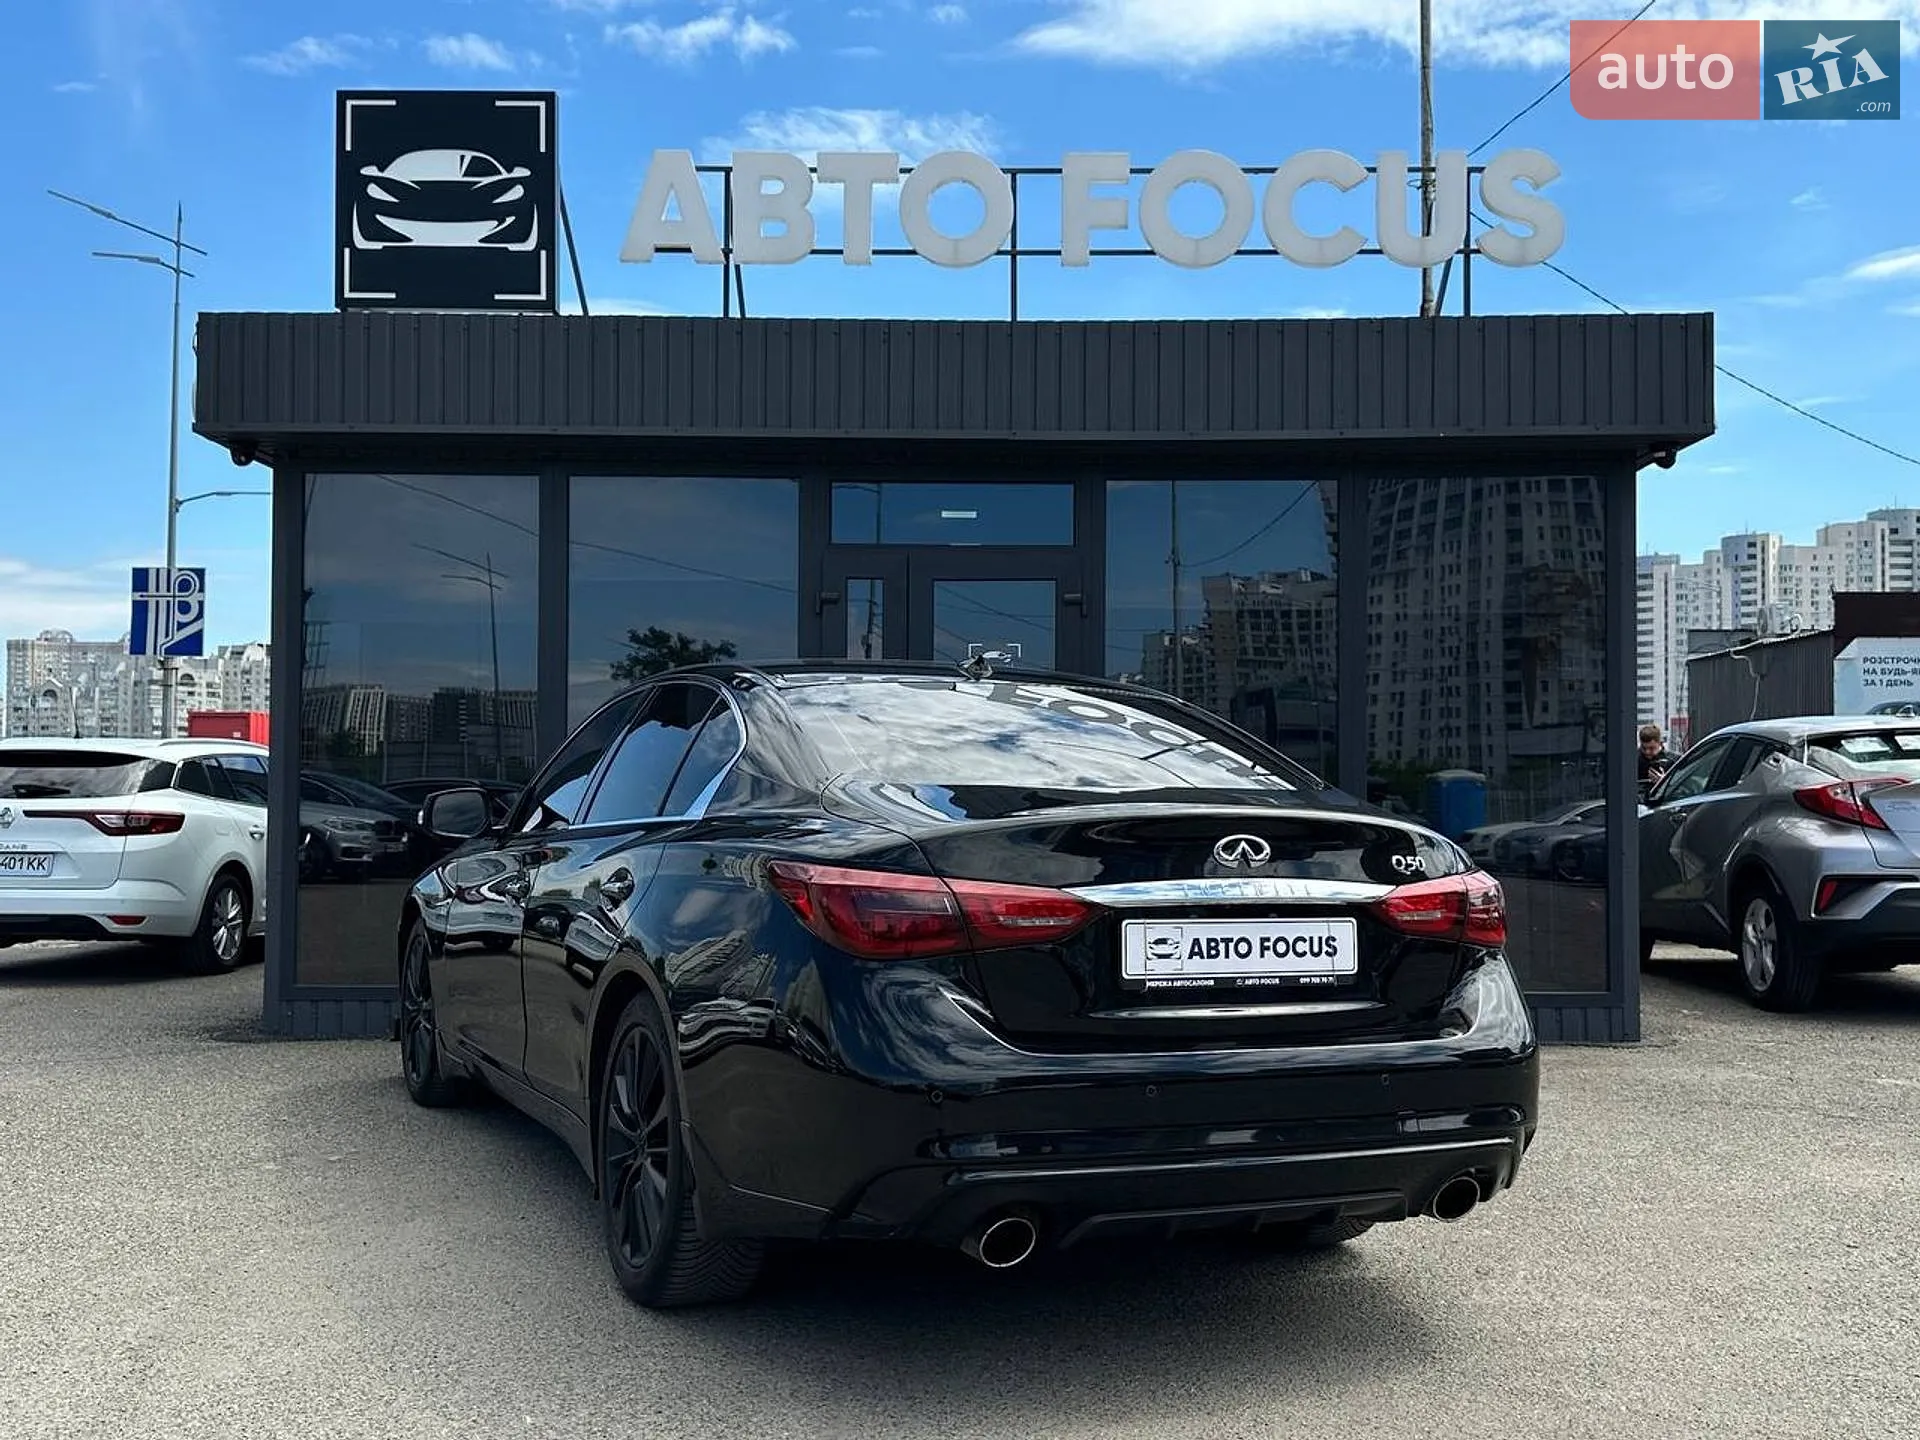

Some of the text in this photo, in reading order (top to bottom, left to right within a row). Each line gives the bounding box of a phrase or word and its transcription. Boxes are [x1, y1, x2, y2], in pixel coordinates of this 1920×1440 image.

[619, 148, 1567, 268] АВТО FOCUS
[1863, 667, 1878, 675] НА
[1863, 679, 1877, 687] ЗА
[1885, 679, 1914, 688] ДЕНЬ
[1391, 855, 1426, 875] Q50
[1187, 935, 1339, 960] АВТО FOCUS
